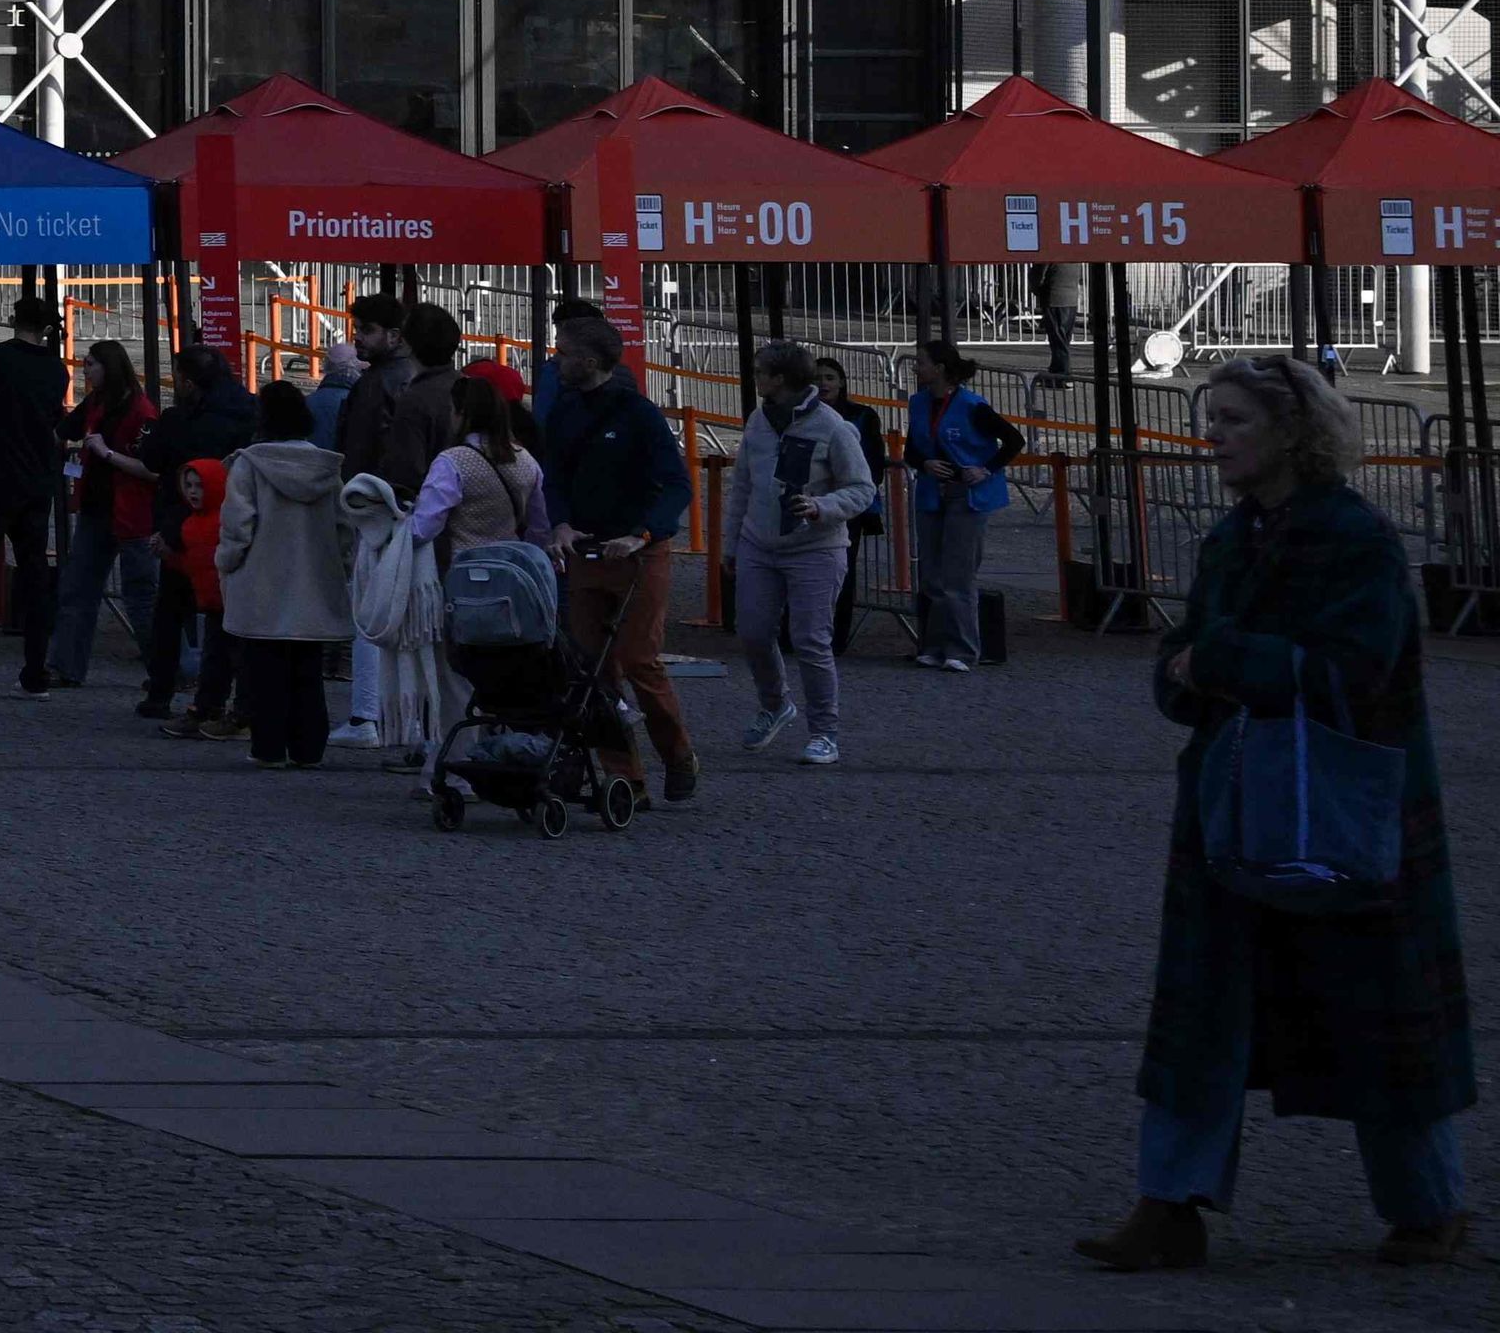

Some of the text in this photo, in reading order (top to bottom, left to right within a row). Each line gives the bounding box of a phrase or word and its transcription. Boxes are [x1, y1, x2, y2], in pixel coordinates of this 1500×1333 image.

[716, 203, 741, 211] Heure
[1092, 203, 1116, 211] Heure
[717, 214, 737, 222] Hour
[1092, 214, 1112, 222] Hour
[37, 211, 102, 238] ticket
[288, 210, 433, 239] Prioritaires
[684, 201, 812, 246] H :00
[1011, 221, 1034, 231] Ticket
[1059, 201, 1187, 246] H :15
[1433, 206, 1465, 249] H
[1386, 225, 1410, 234] Ticket
